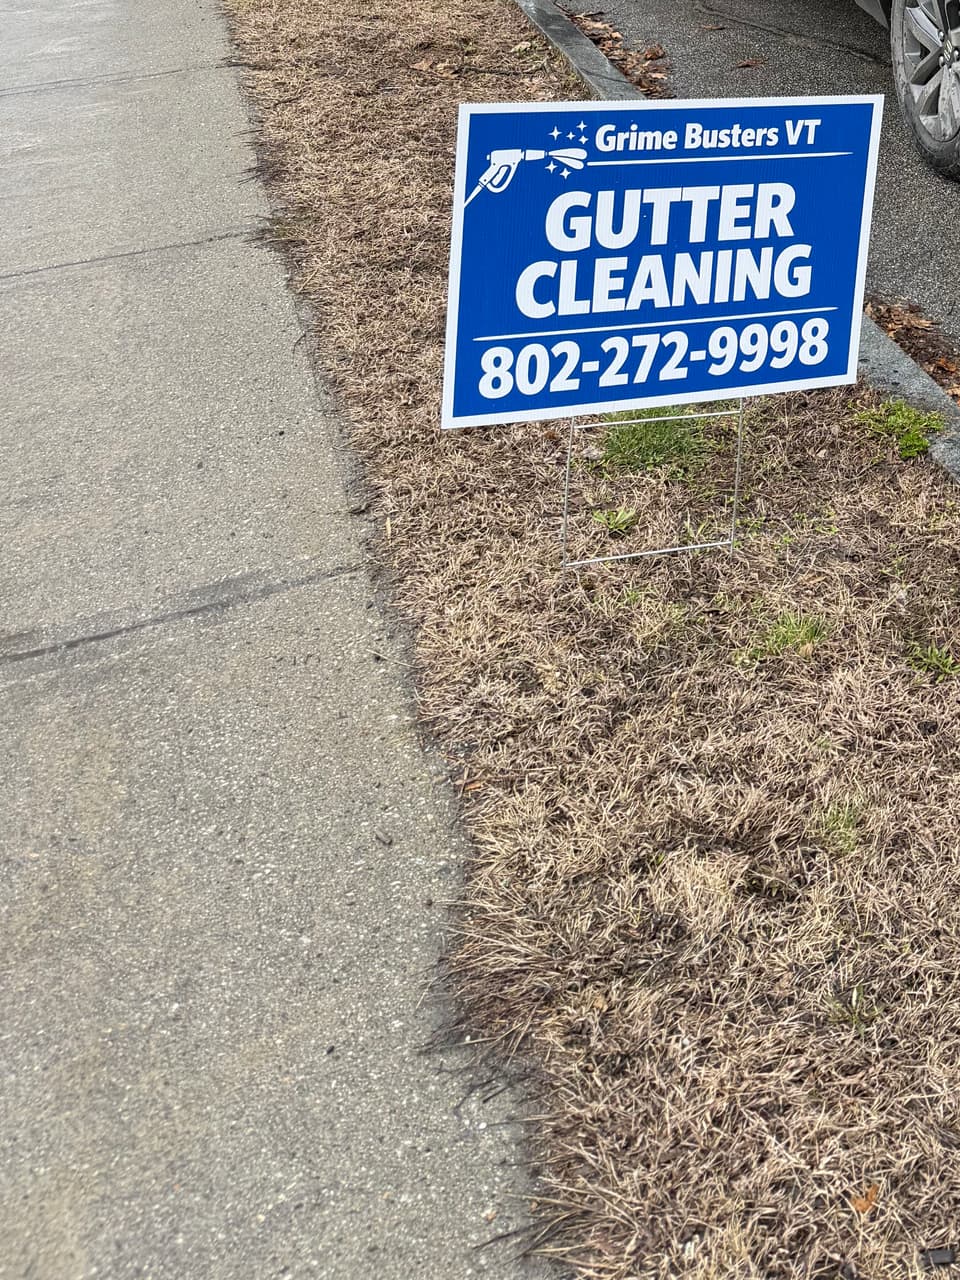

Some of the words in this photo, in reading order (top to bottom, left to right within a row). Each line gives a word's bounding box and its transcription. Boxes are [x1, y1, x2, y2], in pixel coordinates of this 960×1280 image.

[594, 123, 678, 152] Grime
[683, 122, 780, 149] Busters
[785, 118, 822, 146] VT
[545, 182, 796, 252] GUTTER
[515, 244, 812, 319] CLEANING
[478, 317, 830, 399] 802-272-9998
